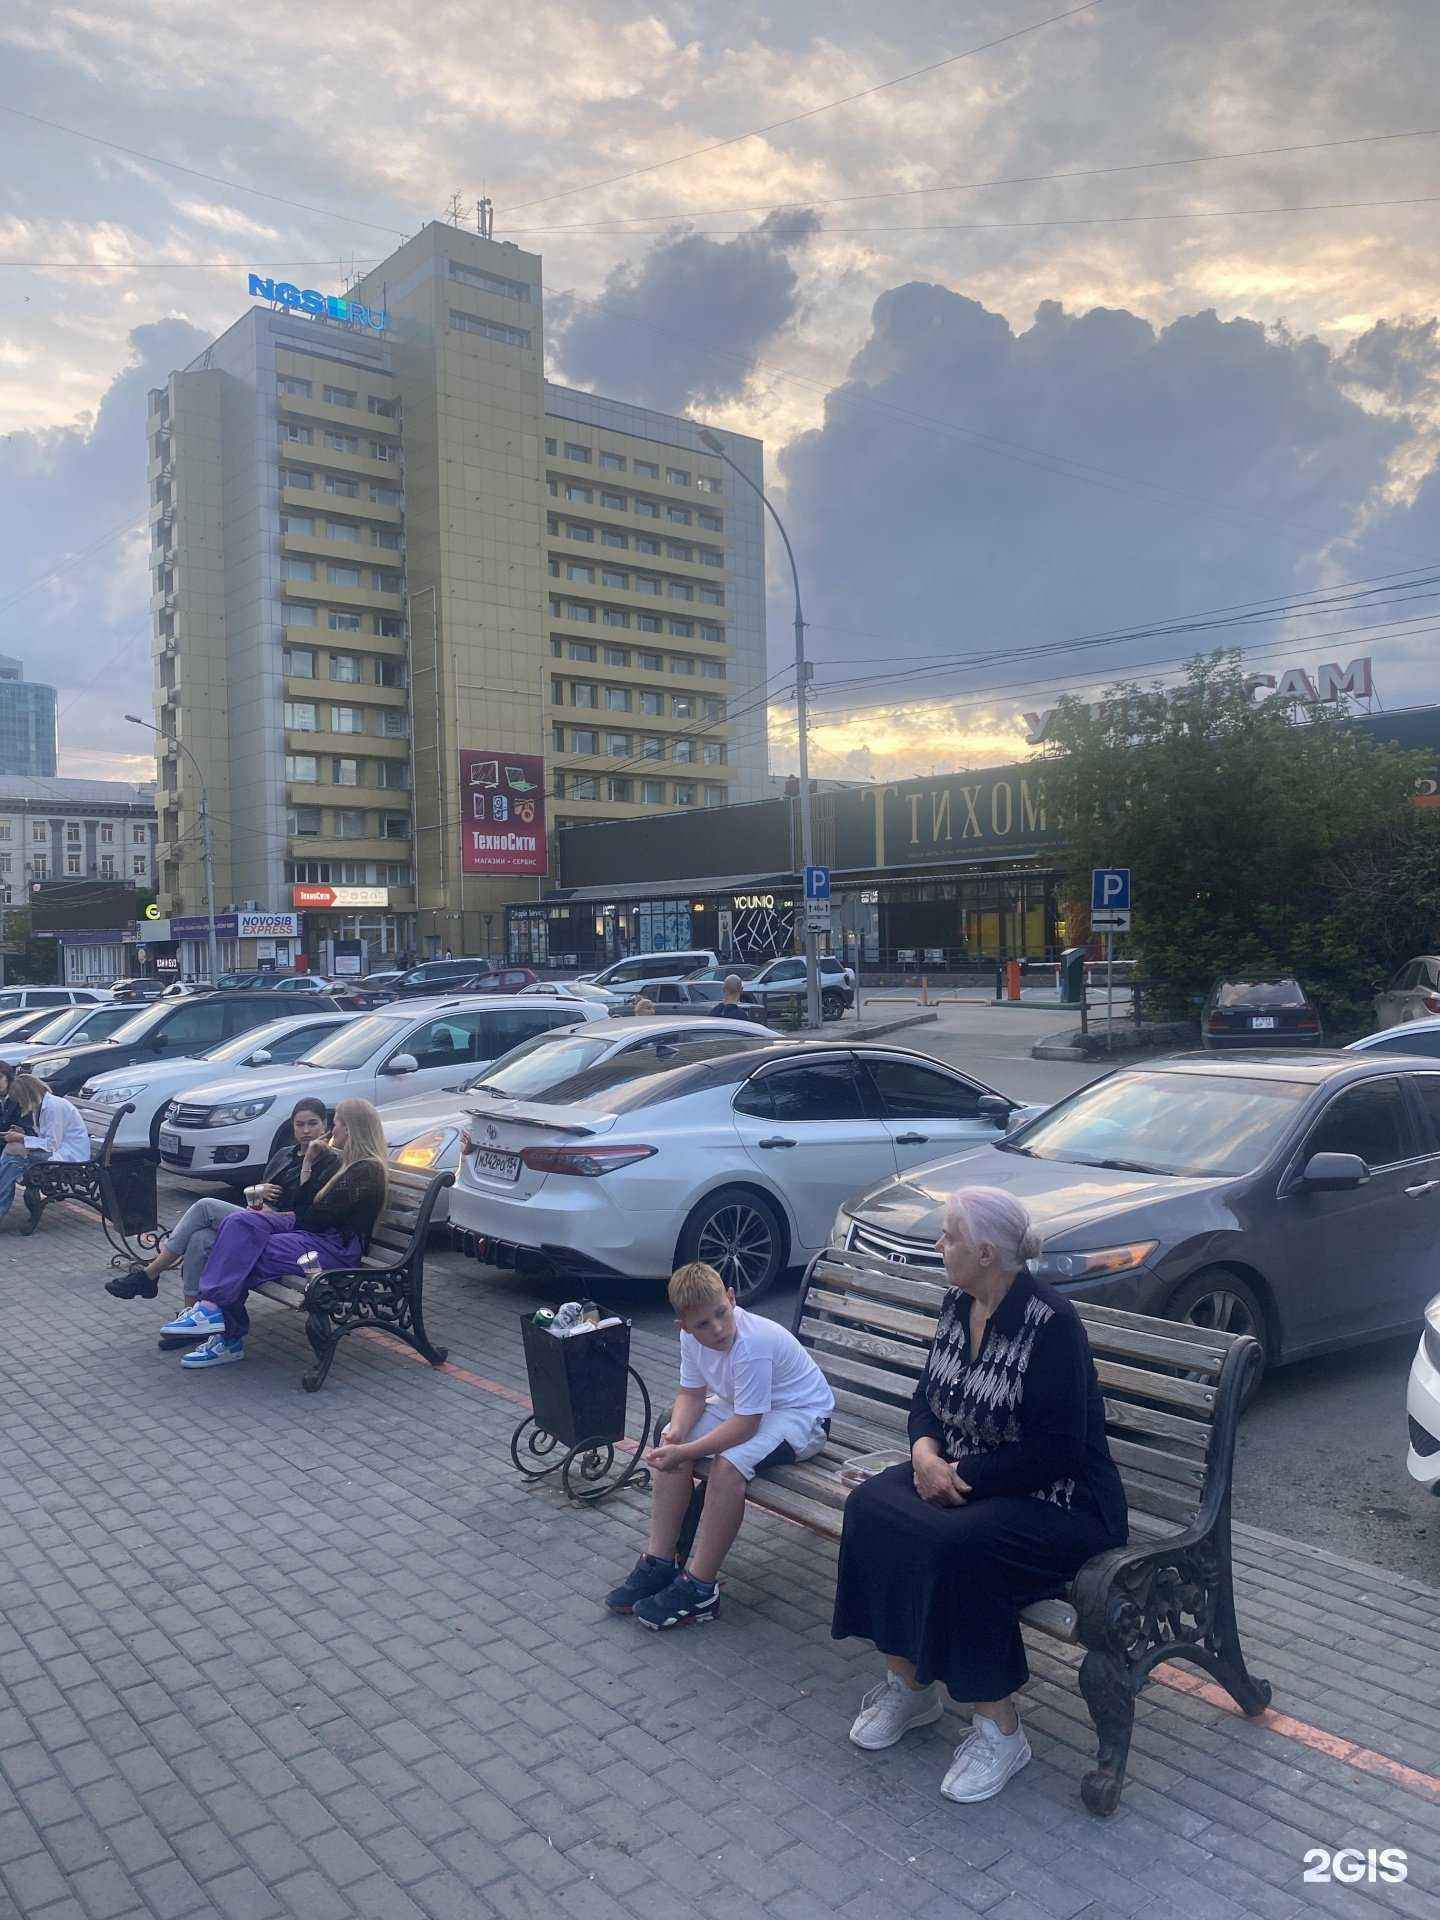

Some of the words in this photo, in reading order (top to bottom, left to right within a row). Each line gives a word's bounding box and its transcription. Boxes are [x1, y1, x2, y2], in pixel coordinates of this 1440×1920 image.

[905, 778, 1056, 844] ТИХОМ
[472, 831, 536, 851] ТехноСити
[474, 857, 506, 865] МАГАЗИН
[512, 858, 537, 866] СЕРВИС
[1103, 874, 1123, 905] P
[242, 916, 292, 926] NOVOSIB
[242, 925, 293, 935] EXPRESS
